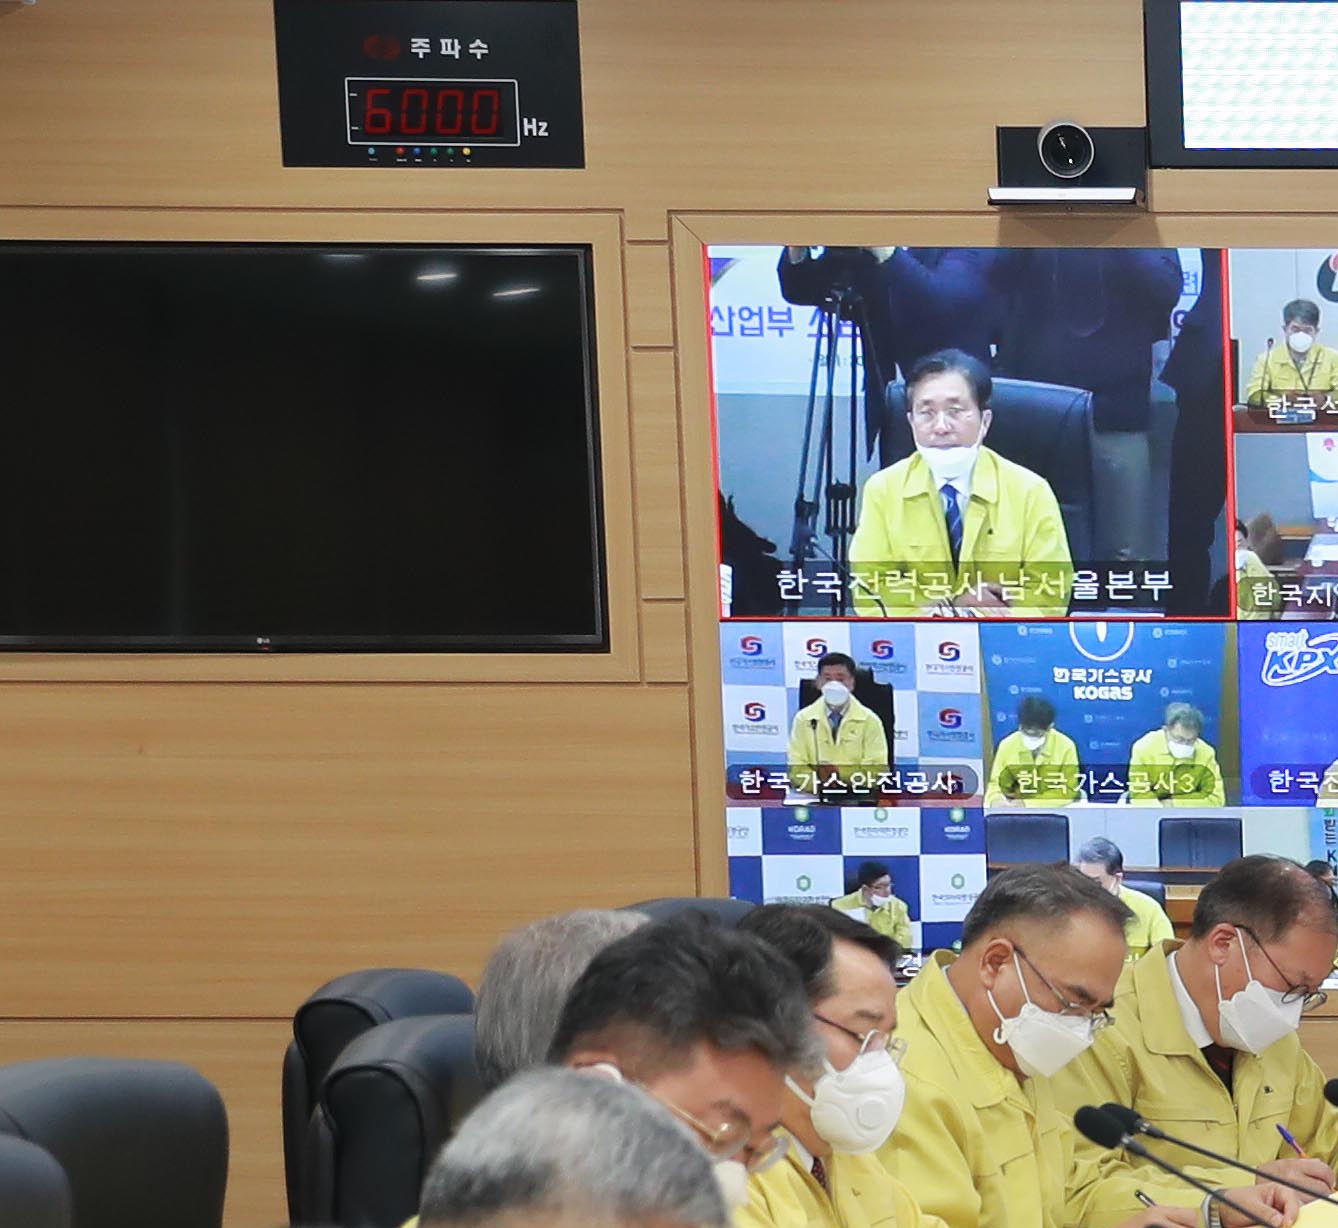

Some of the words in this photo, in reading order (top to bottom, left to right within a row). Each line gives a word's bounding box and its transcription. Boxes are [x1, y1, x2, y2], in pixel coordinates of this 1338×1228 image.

[411, 38, 489, 59] 주파수
[365, 89, 499, 135] 6000
[523, 118, 549, 137] Hz
[776, 569, 984, 603] 한국전력공사
[1000, 569, 1174, 603] 남서울본부
[1053, 666, 1152, 684] 한국가스공사
[739, 769, 957, 795] 한국가스안전공사
[1017, 770, 1195, 795] 한국가스공사3
